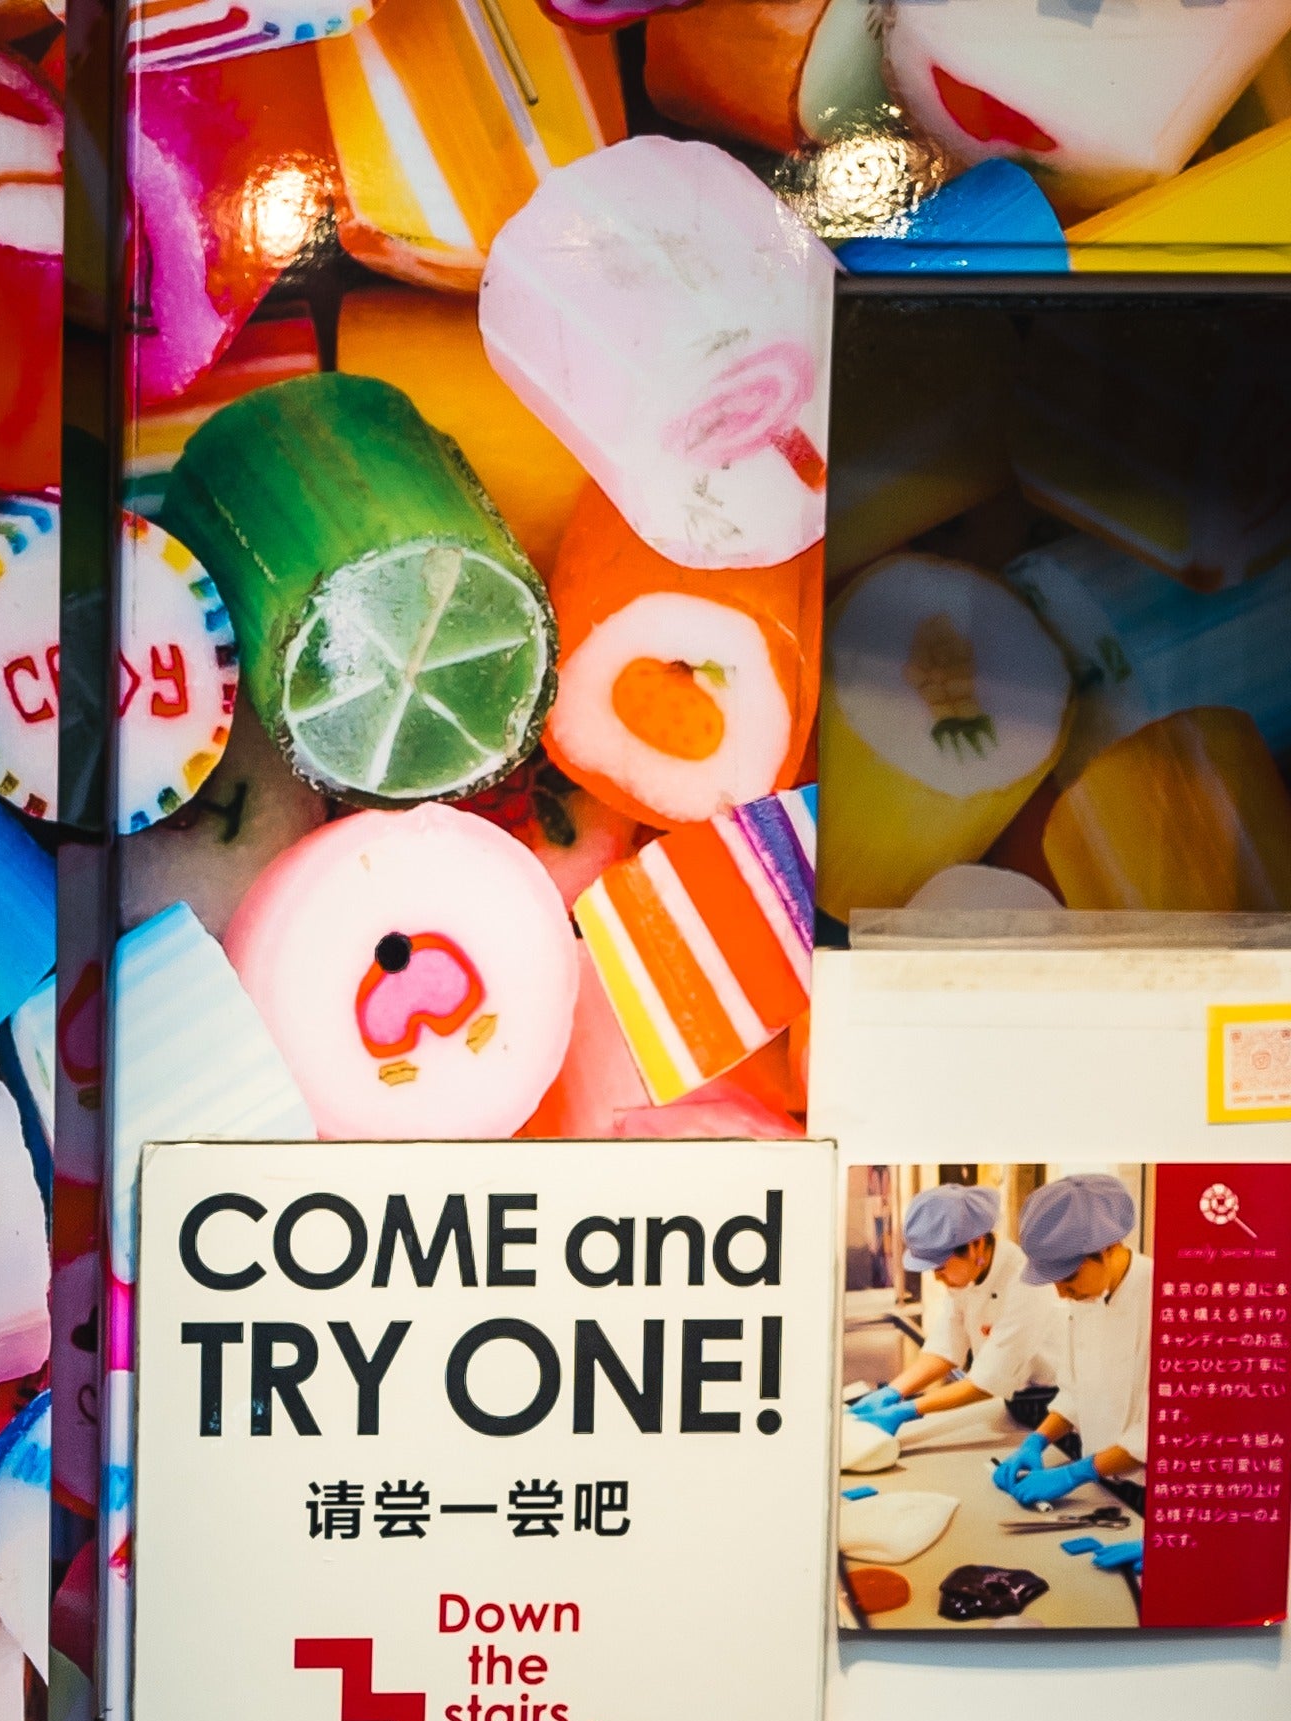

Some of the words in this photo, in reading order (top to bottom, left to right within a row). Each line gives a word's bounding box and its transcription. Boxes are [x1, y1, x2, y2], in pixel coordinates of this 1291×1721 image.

[179, 1192, 538, 1290] COME
[564, 1189, 783, 1287] and
[180, 1320, 413, 1438] TRY
[444, 1315, 783, 1438] ONE!
[305, 1479, 631, 1541] 请尝一尝吧
[438, 1593, 581, 1634] Down
[468, 1646, 549, 1686] the
